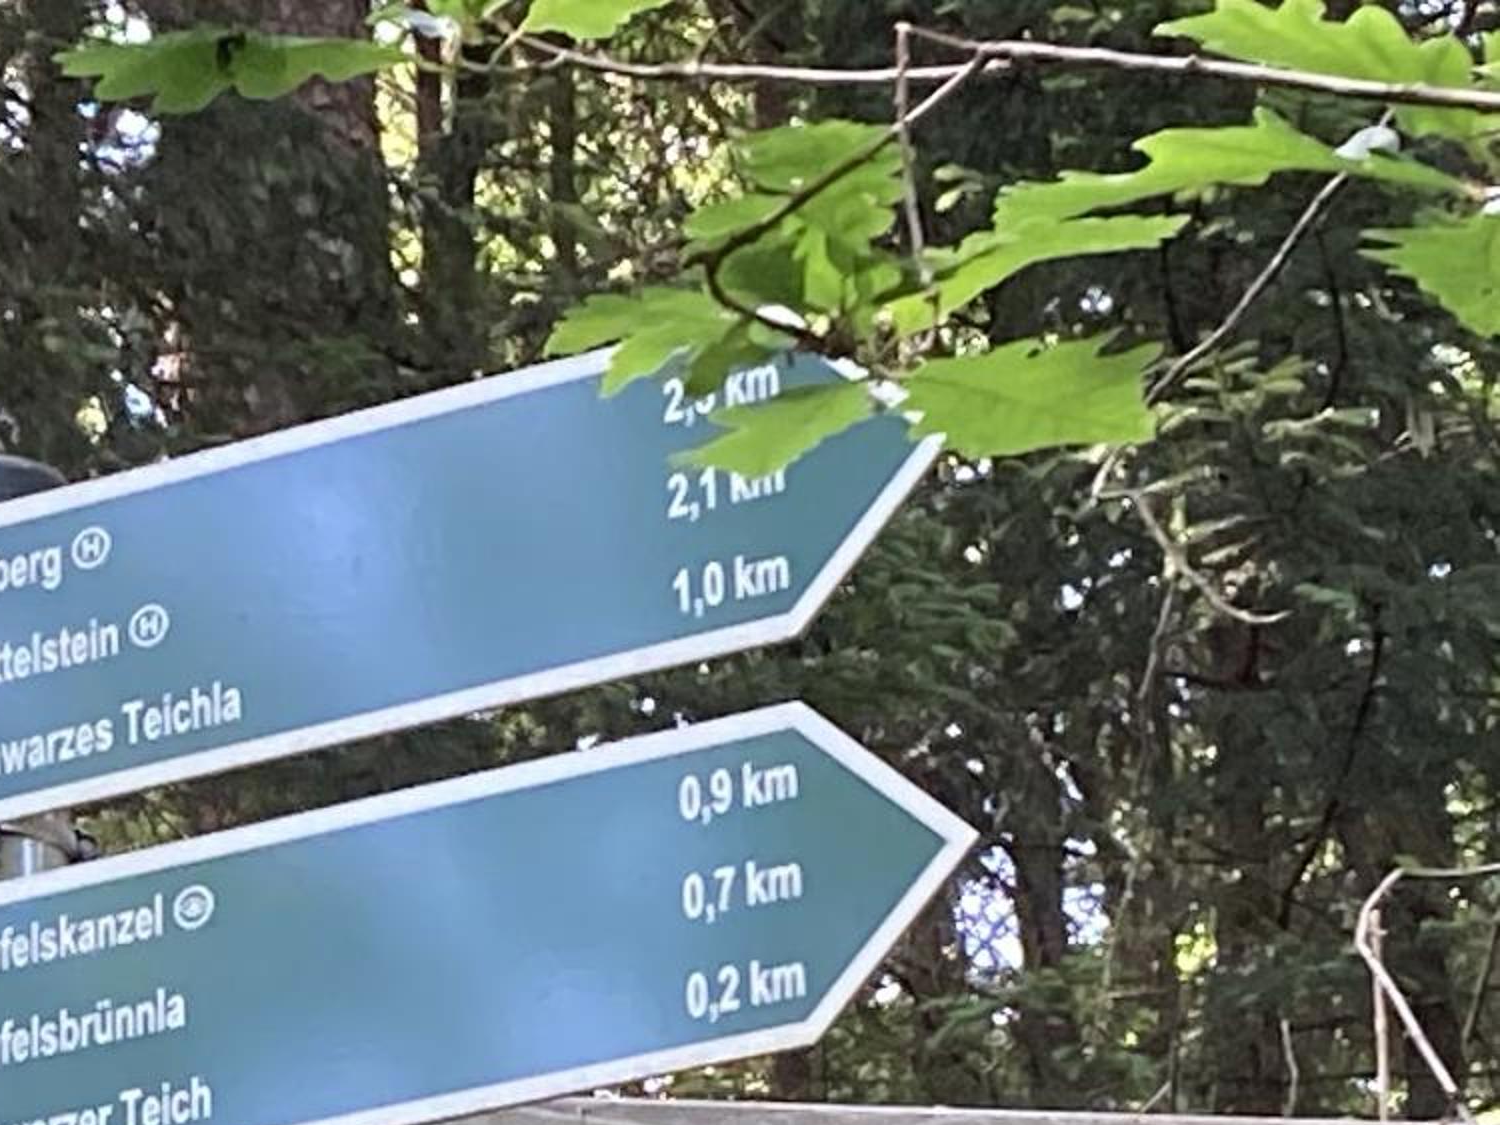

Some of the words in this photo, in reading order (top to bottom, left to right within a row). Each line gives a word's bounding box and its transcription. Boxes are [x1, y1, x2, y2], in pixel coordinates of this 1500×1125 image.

[724, 364, 781, 409] km
[667, 466, 718, 522] 2,1
[672, 560, 725, 618] 1,0
[733, 554, 791, 601] km
[122, 681, 243, 745] Teichla
[678, 768, 733, 826] 0,9
[741, 761, 799, 808] km
[682, 865, 737, 924] 0,7
[745, 860, 803, 907] km
[686, 964, 741, 1024] 0,2
[749, 959, 807, 1007] km
